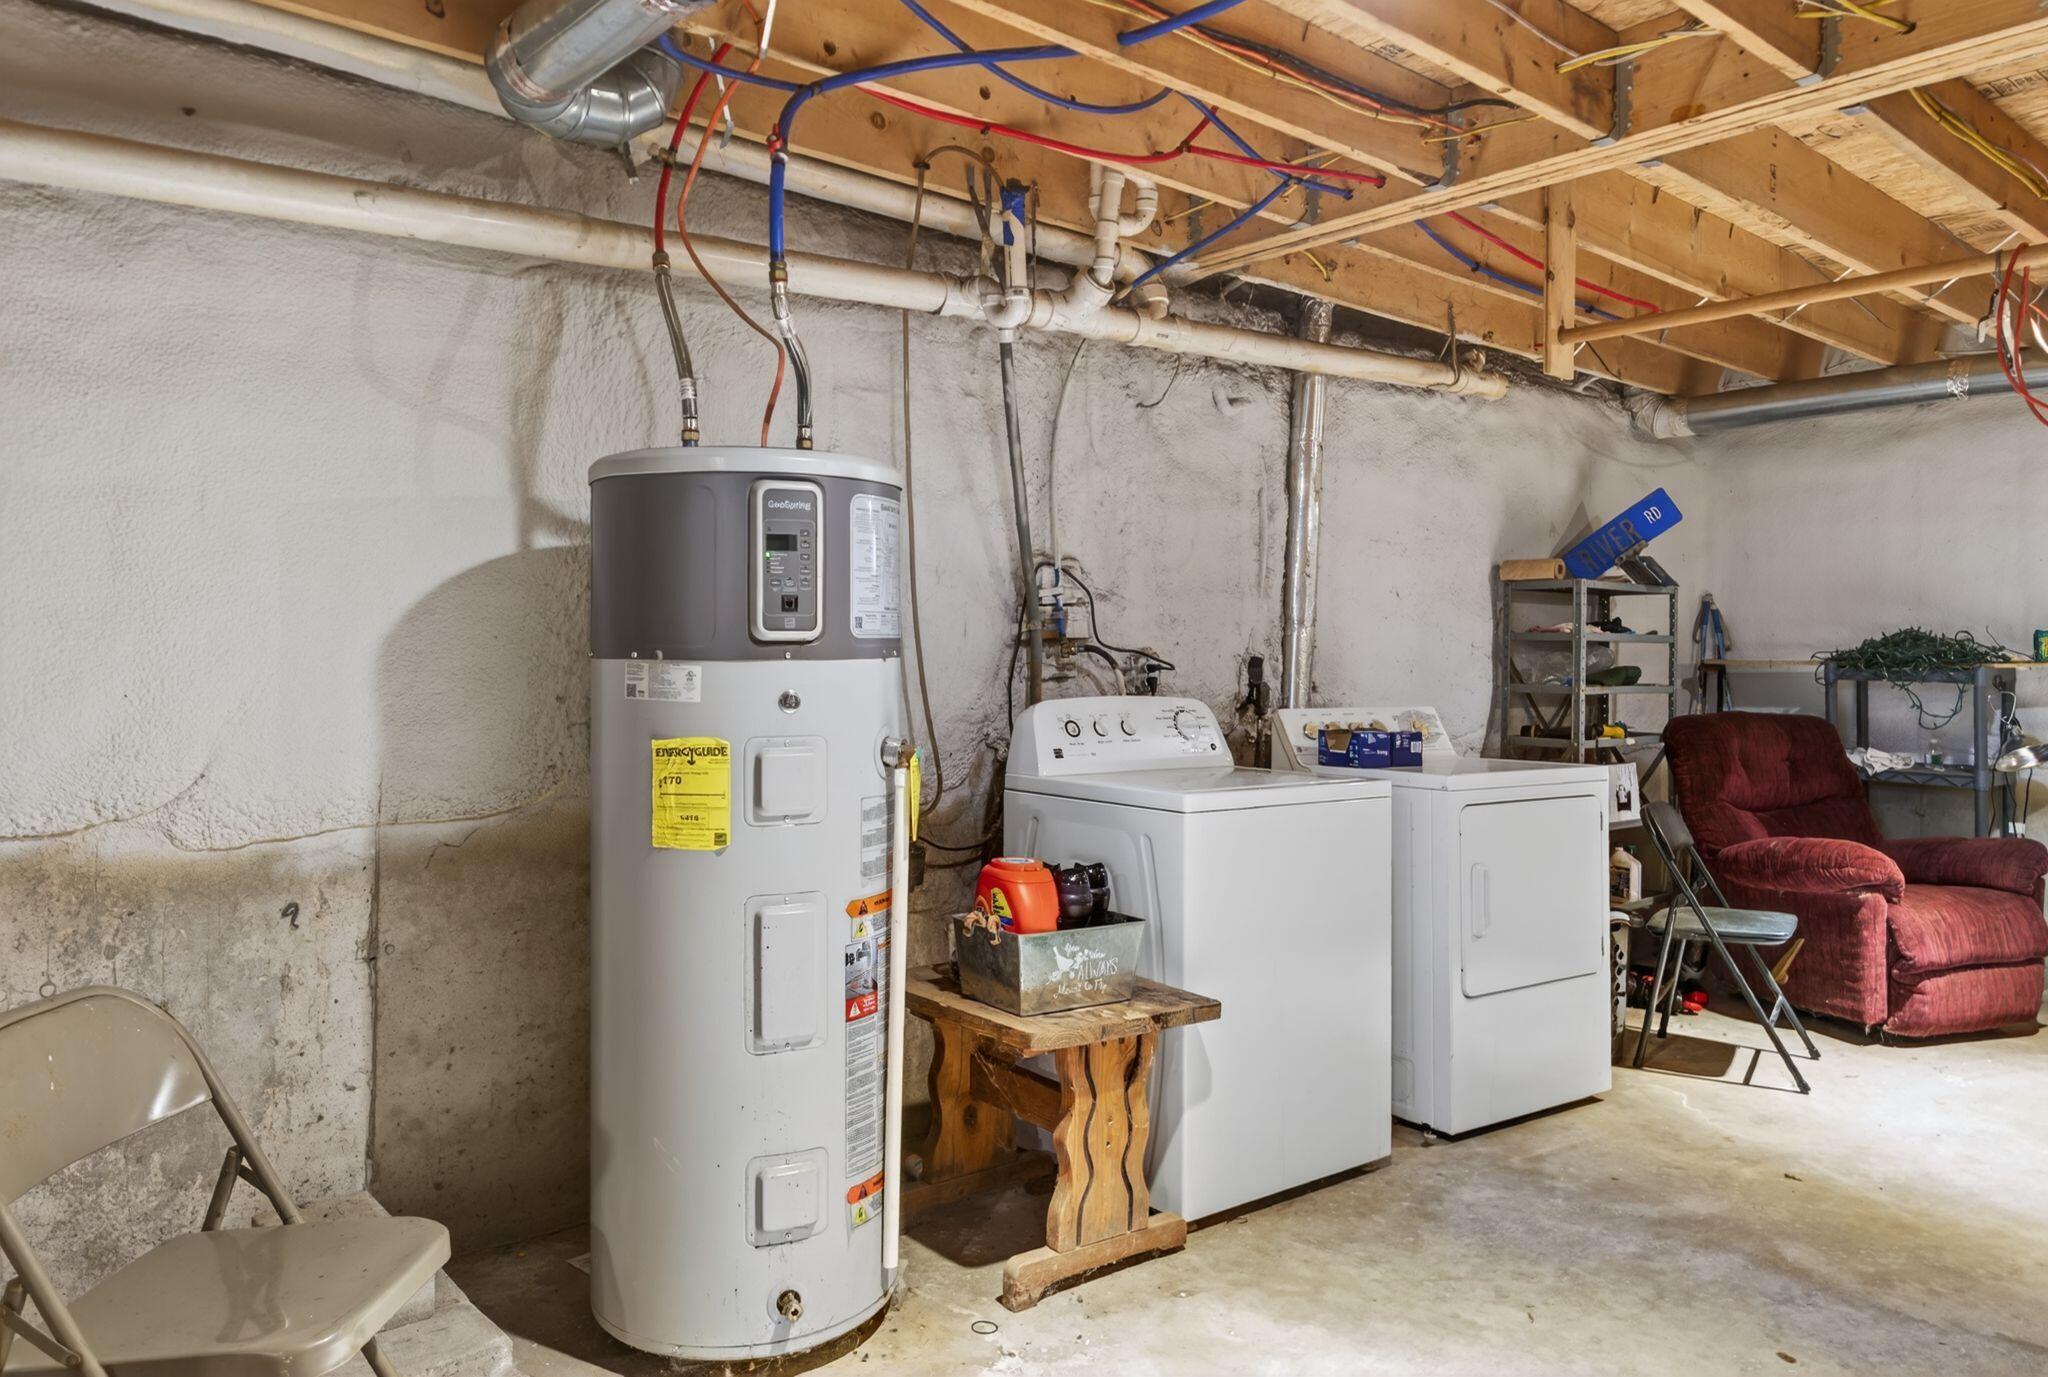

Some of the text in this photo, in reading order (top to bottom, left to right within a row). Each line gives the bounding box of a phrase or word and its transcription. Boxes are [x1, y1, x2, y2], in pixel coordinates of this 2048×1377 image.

[767, 499, 812, 511] GeoSpring
[1577, 506, 1662, 572] RIVER RD
[655, 746, 729, 758] ENERGYGUIDE
[1077, 957, 1119, 981] ALWAYS
